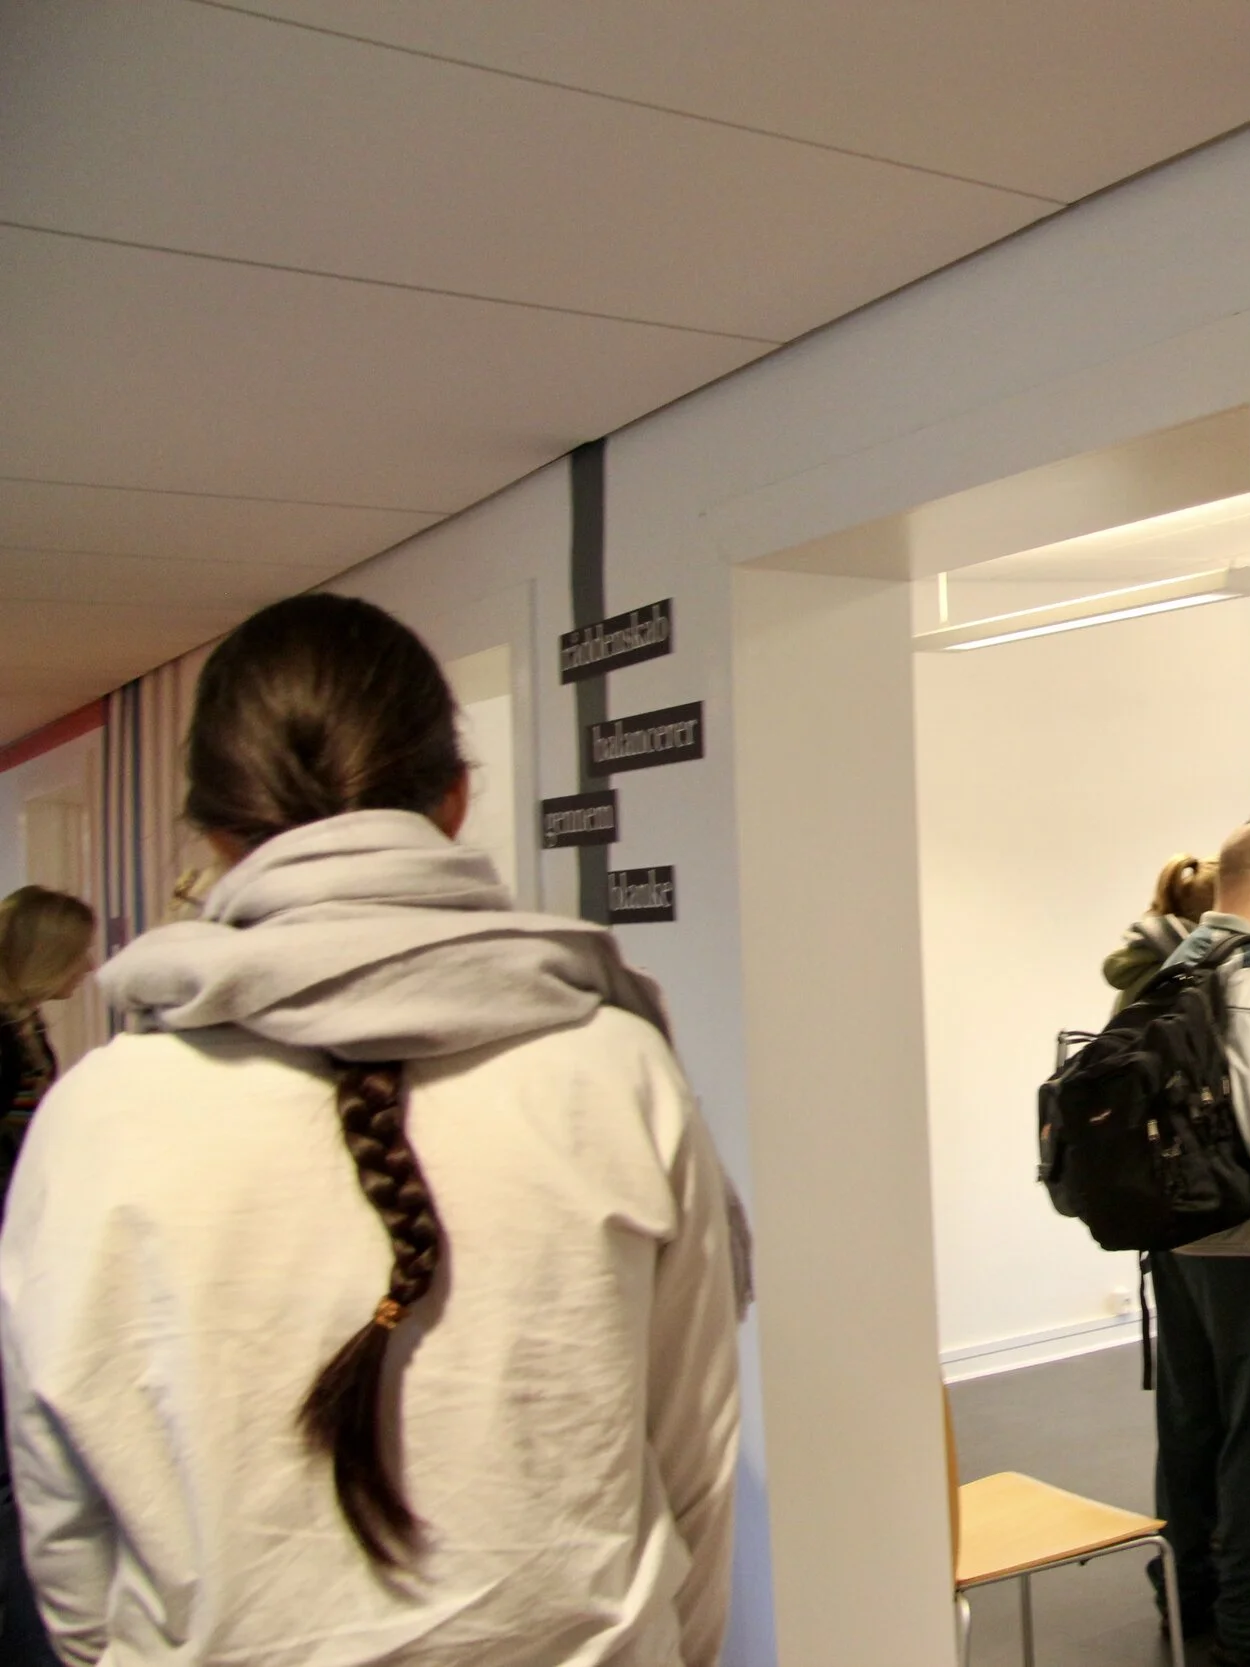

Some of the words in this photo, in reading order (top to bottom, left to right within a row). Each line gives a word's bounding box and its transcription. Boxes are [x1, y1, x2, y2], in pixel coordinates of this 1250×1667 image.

[592, 720, 698, 763] balancerer
[543, 804, 615, 848] gennem
[607, 869, 674, 911] blanke
